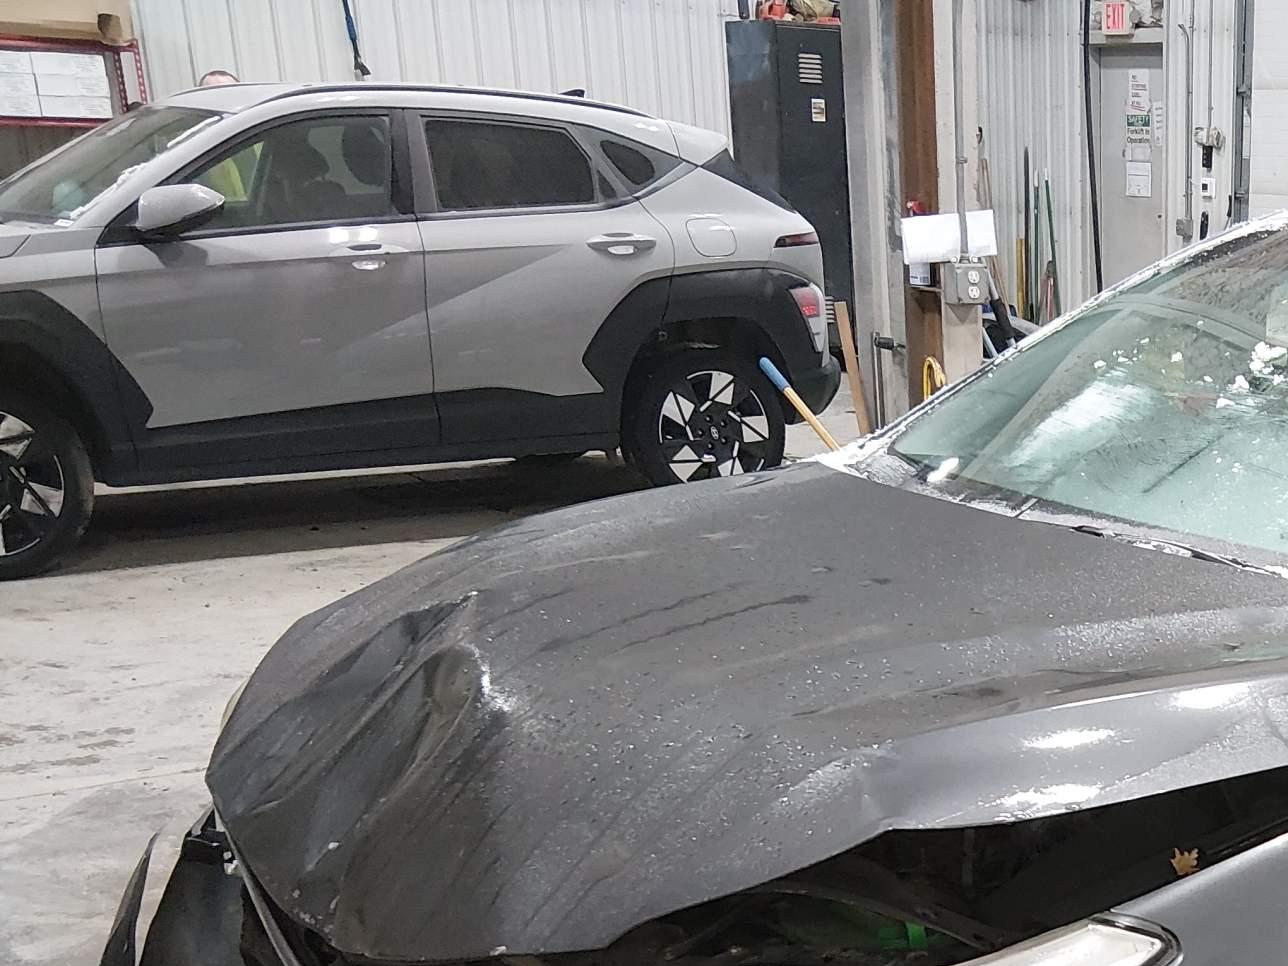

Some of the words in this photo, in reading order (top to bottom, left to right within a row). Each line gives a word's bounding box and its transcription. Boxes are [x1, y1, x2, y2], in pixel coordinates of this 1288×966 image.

[1106, 4, 1124, 29] EXIT
[1128, 115, 1149, 123] SAFETY
[1127, 136, 1150, 144] Operation
